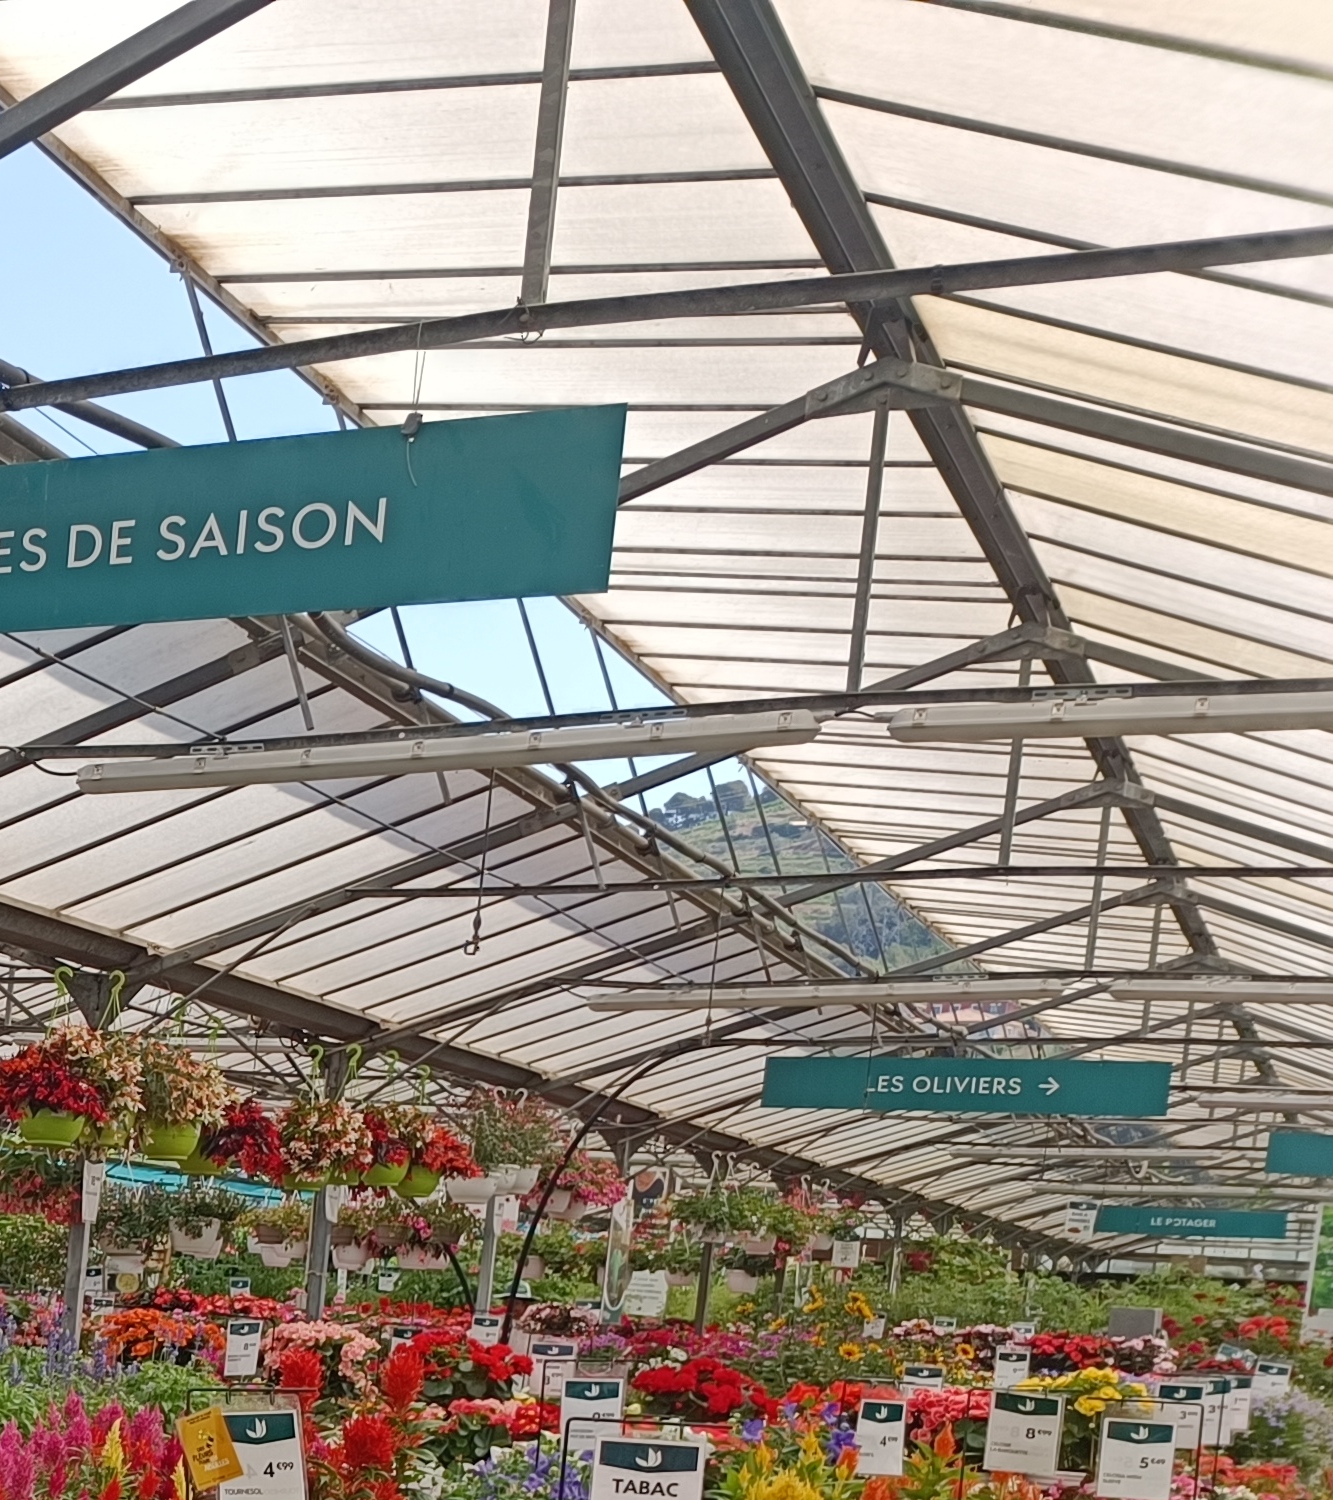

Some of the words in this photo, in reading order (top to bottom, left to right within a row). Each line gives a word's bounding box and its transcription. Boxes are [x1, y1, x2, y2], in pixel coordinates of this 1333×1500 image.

[67, 519, 135, 569] DE
[156, 497, 387, 561] SAISON
[912, 1075, 1022, 1095] OLIVIERS
[1150, 1216, 1162, 1227] LE
[1165, 1217, 1217, 1228] POTAGER
[224, 1487, 264, 1496] TOURNESOL
[612, 1478, 679, 1498] TABAC
